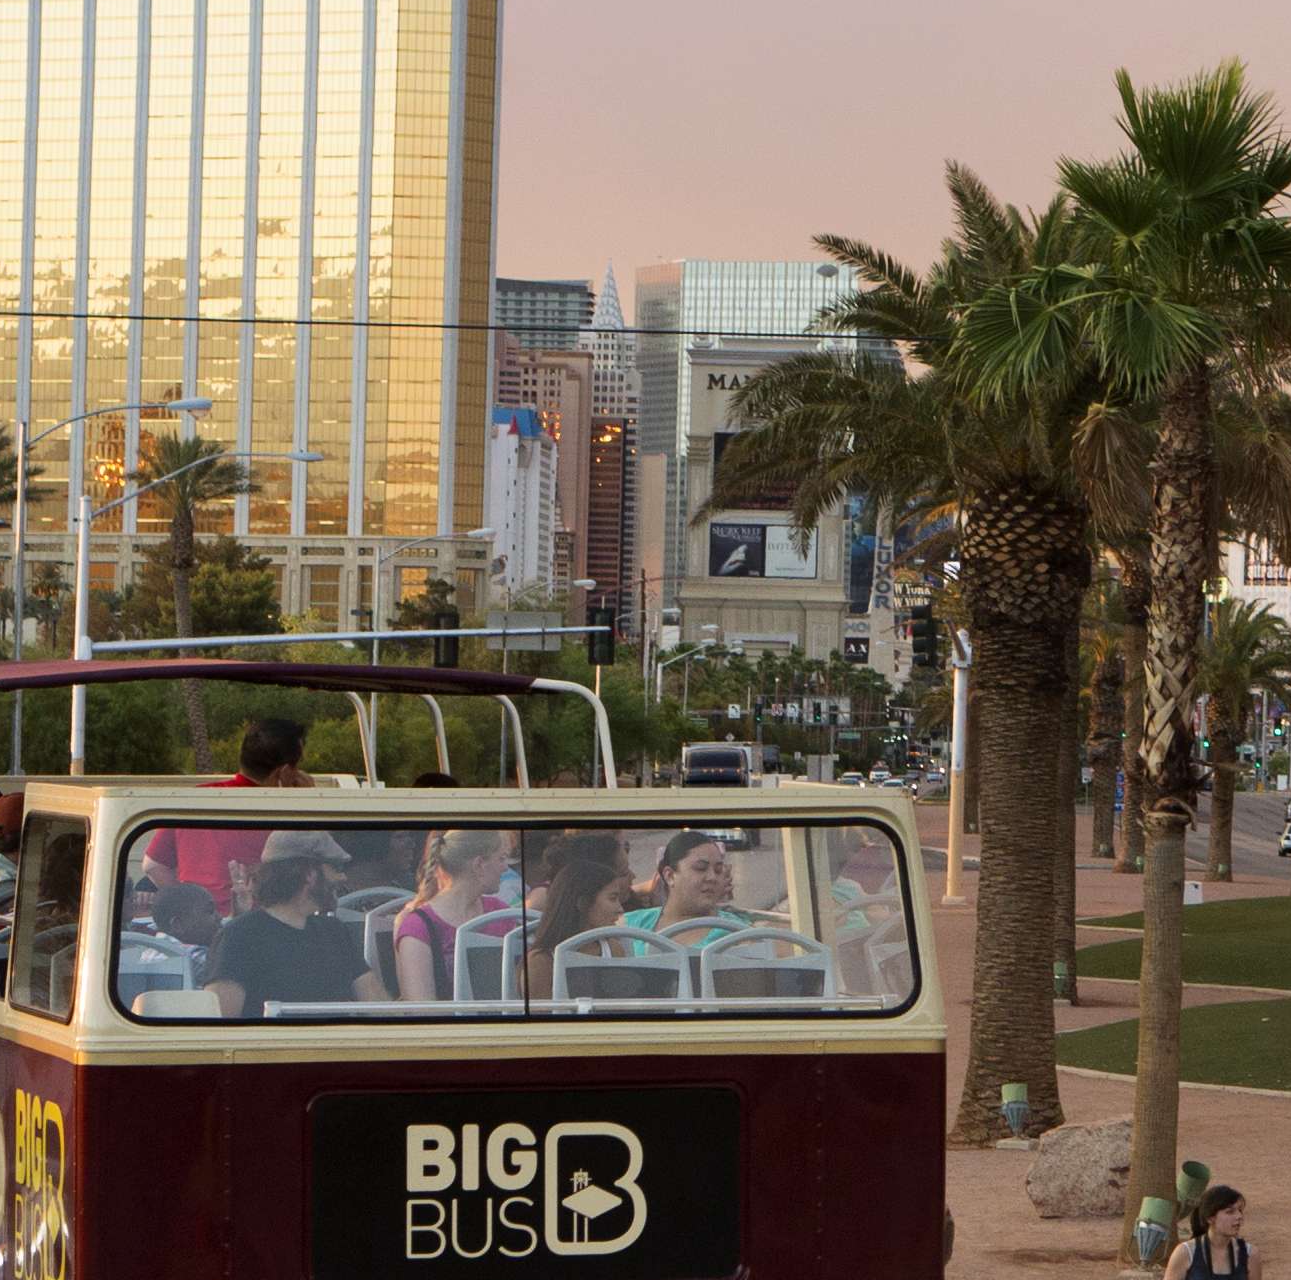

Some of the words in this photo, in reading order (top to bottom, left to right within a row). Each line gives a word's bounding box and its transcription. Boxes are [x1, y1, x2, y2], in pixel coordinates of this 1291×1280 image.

[874, 537, 892, 609] LUXOR
[15, 1088, 42, 1193] BIG
[406, 1122, 538, 1192] BIG
[406, 1196, 538, 1259] BUS
